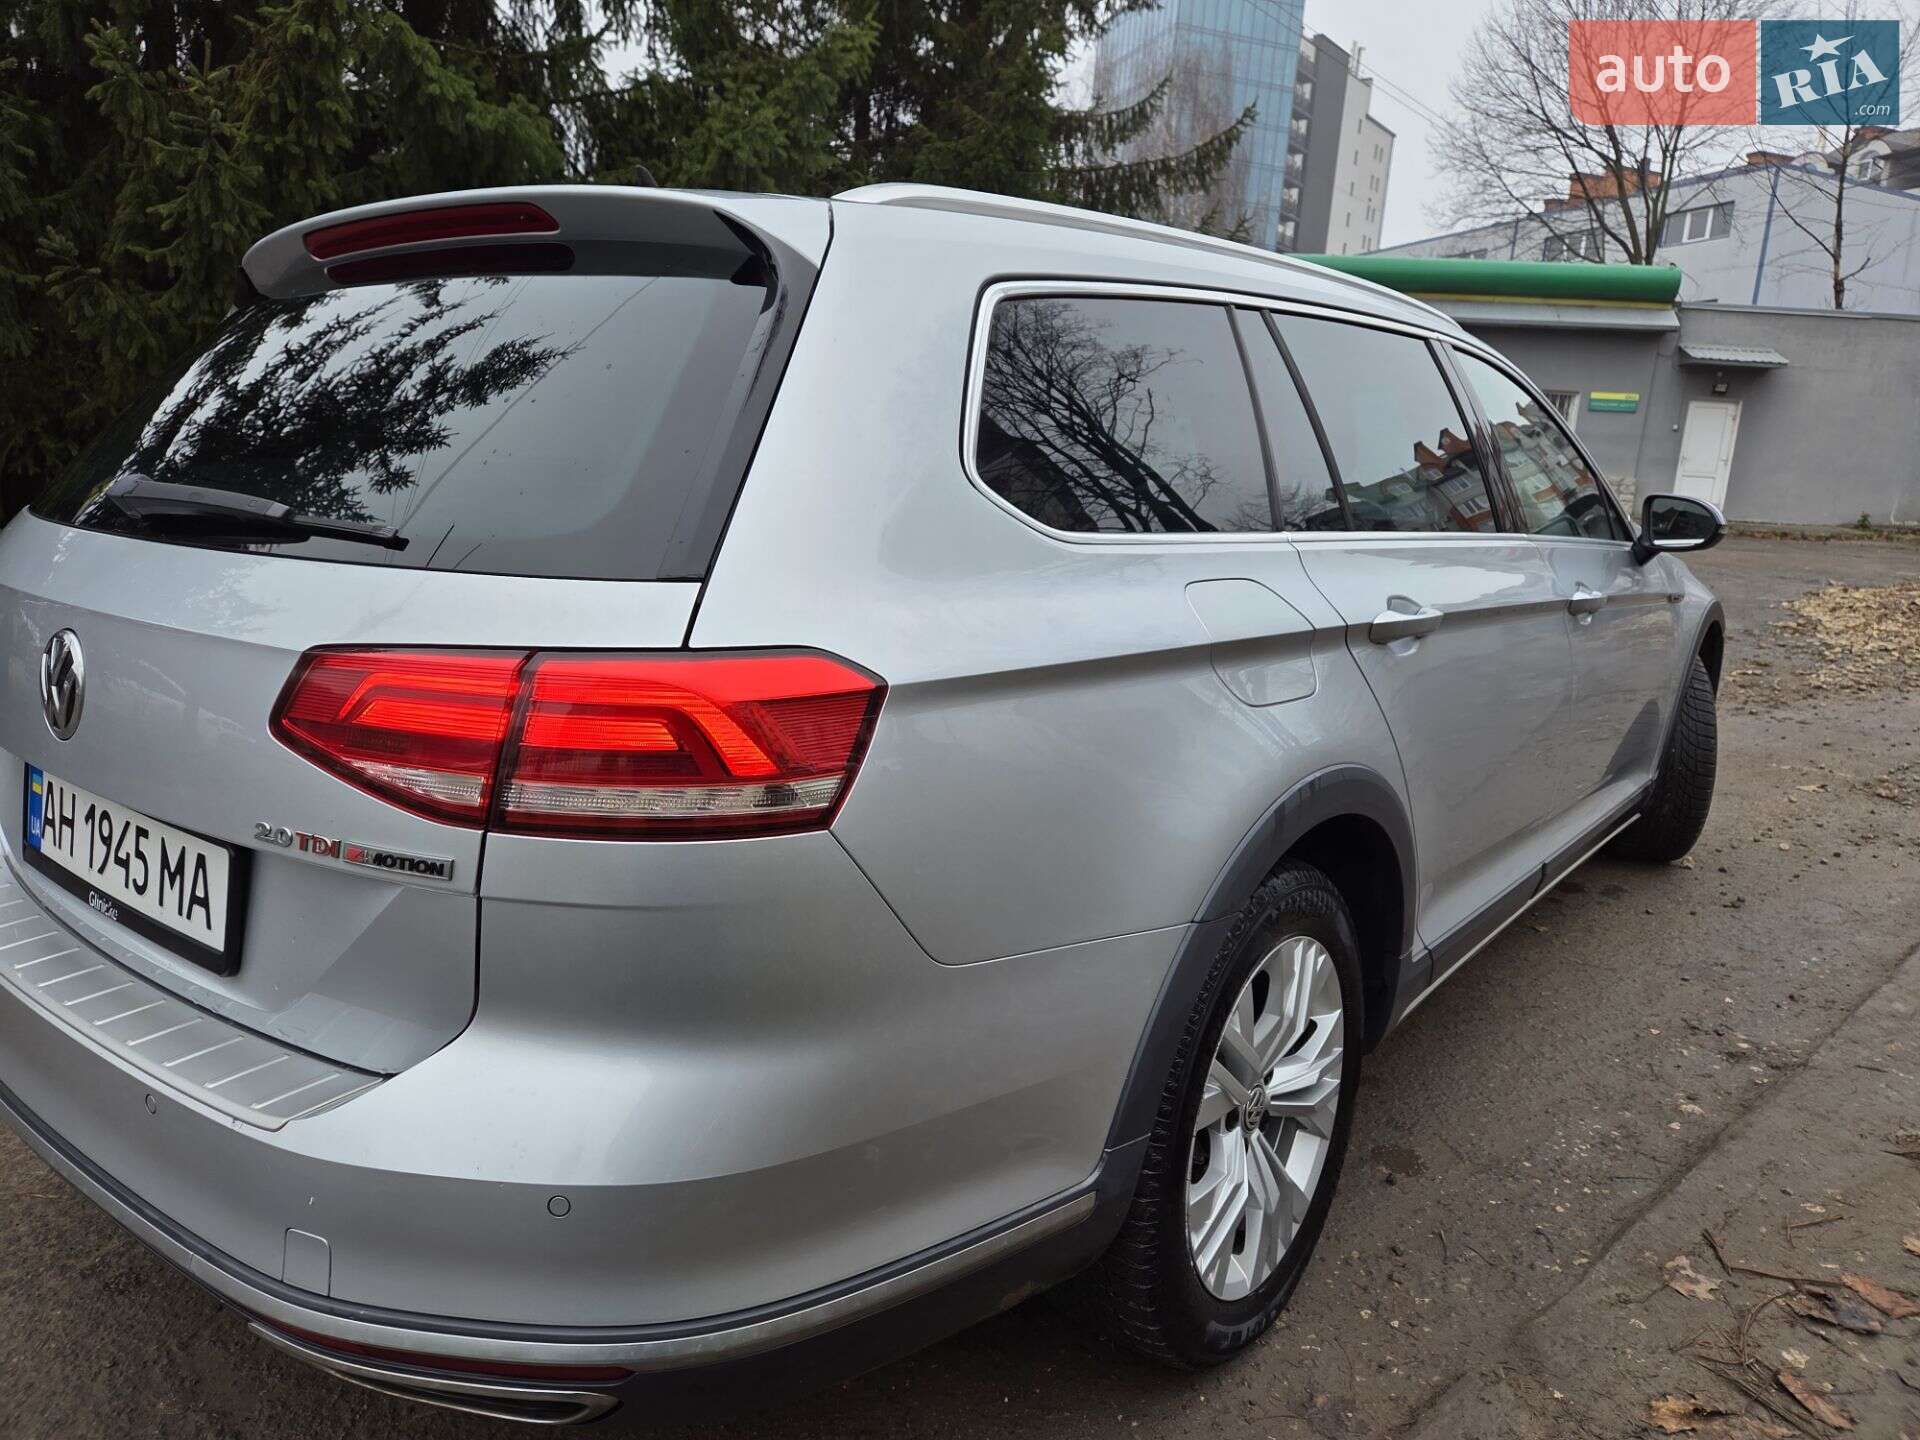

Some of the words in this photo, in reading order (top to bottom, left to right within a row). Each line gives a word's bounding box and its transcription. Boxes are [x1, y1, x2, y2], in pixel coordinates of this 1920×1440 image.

[31, 815, 41, 838] UA
[41, 780, 76, 858] AH
[84, 803, 150, 896] 1945
[158, 836, 212, 931] MA
[295, 830, 342, 859] TDI
